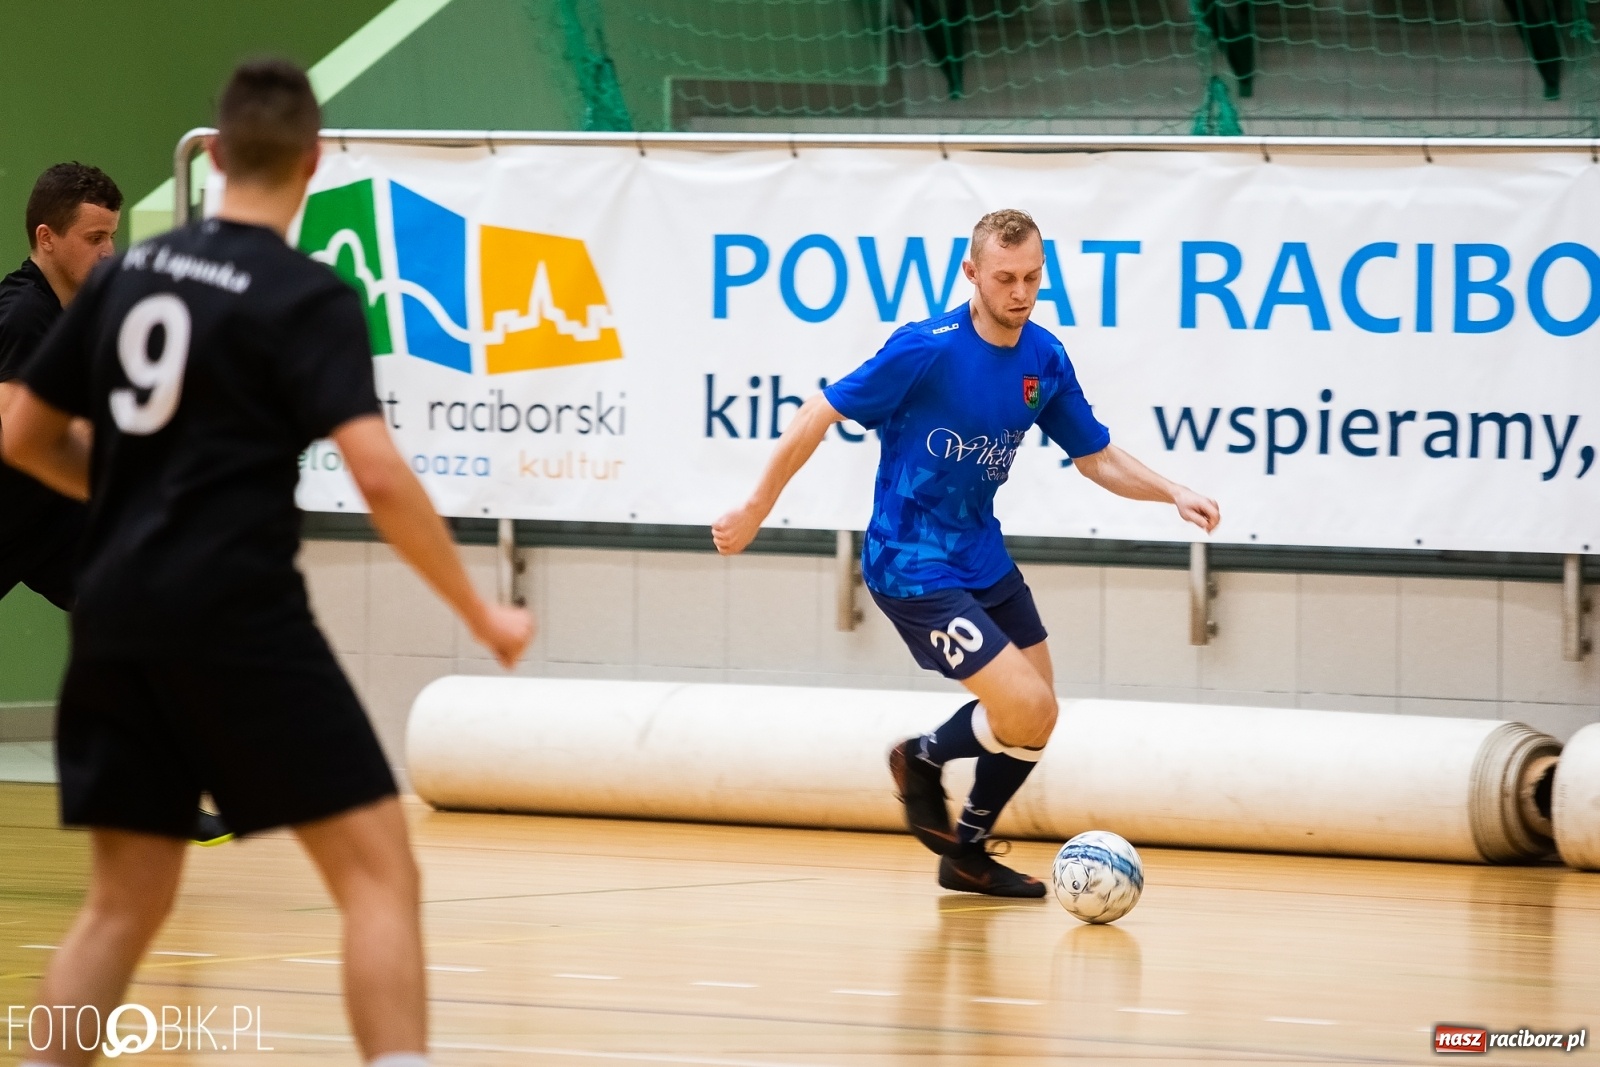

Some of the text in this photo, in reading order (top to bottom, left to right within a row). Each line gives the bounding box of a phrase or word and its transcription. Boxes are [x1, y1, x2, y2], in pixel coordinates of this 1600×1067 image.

[1180, 240, 1600, 337] RACIBO
[109, 292, 192, 435] 9
[428, 388, 626, 435] raciborski
[1153, 388, 1596, 482] wspieramy,
[412, 450, 625, 480] oaza kultur
[930, 616, 984, 670] 20
